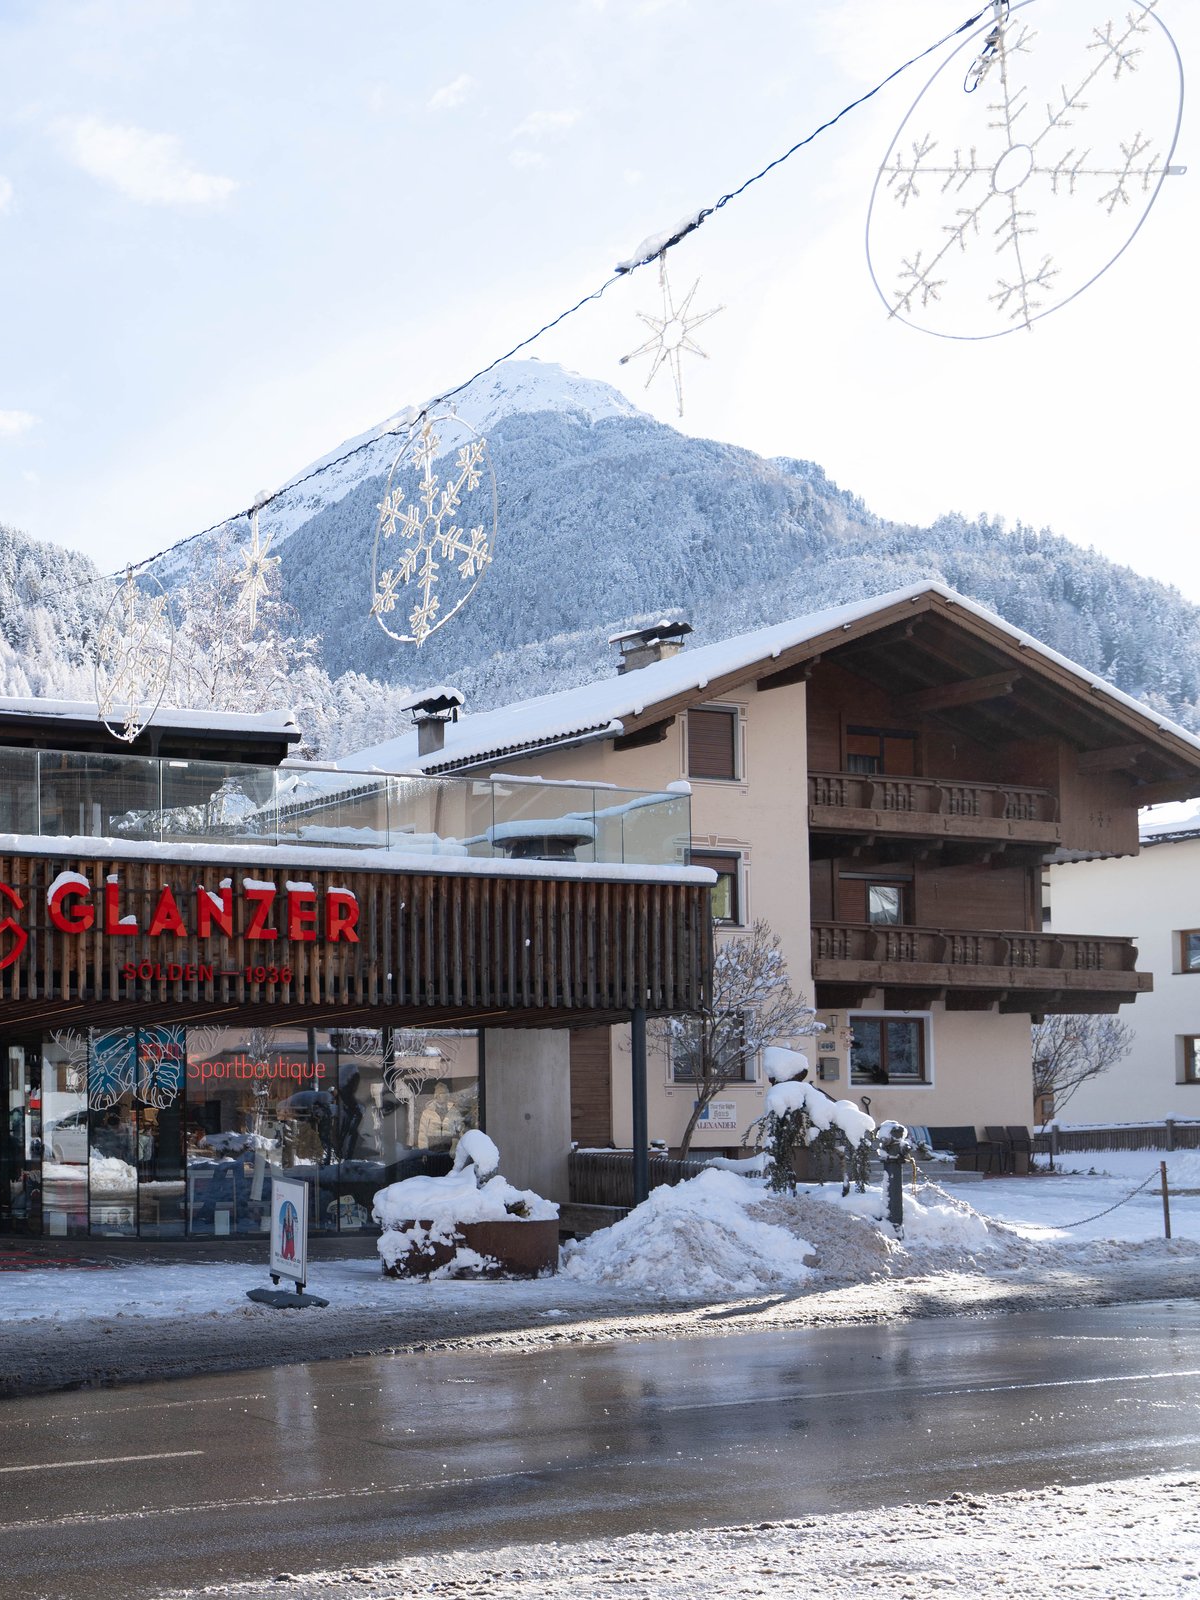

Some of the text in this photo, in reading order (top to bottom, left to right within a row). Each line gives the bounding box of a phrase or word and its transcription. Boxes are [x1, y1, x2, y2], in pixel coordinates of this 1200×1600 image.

[47, 878, 359, 943] GLANZER
[123, 959, 214, 982] SÖLDEN
[246, 966, 292, 984] 1936
[187, 1054, 326, 1085] Sportboutique
[696, 1121, 736, 1129] ALEXANDER
